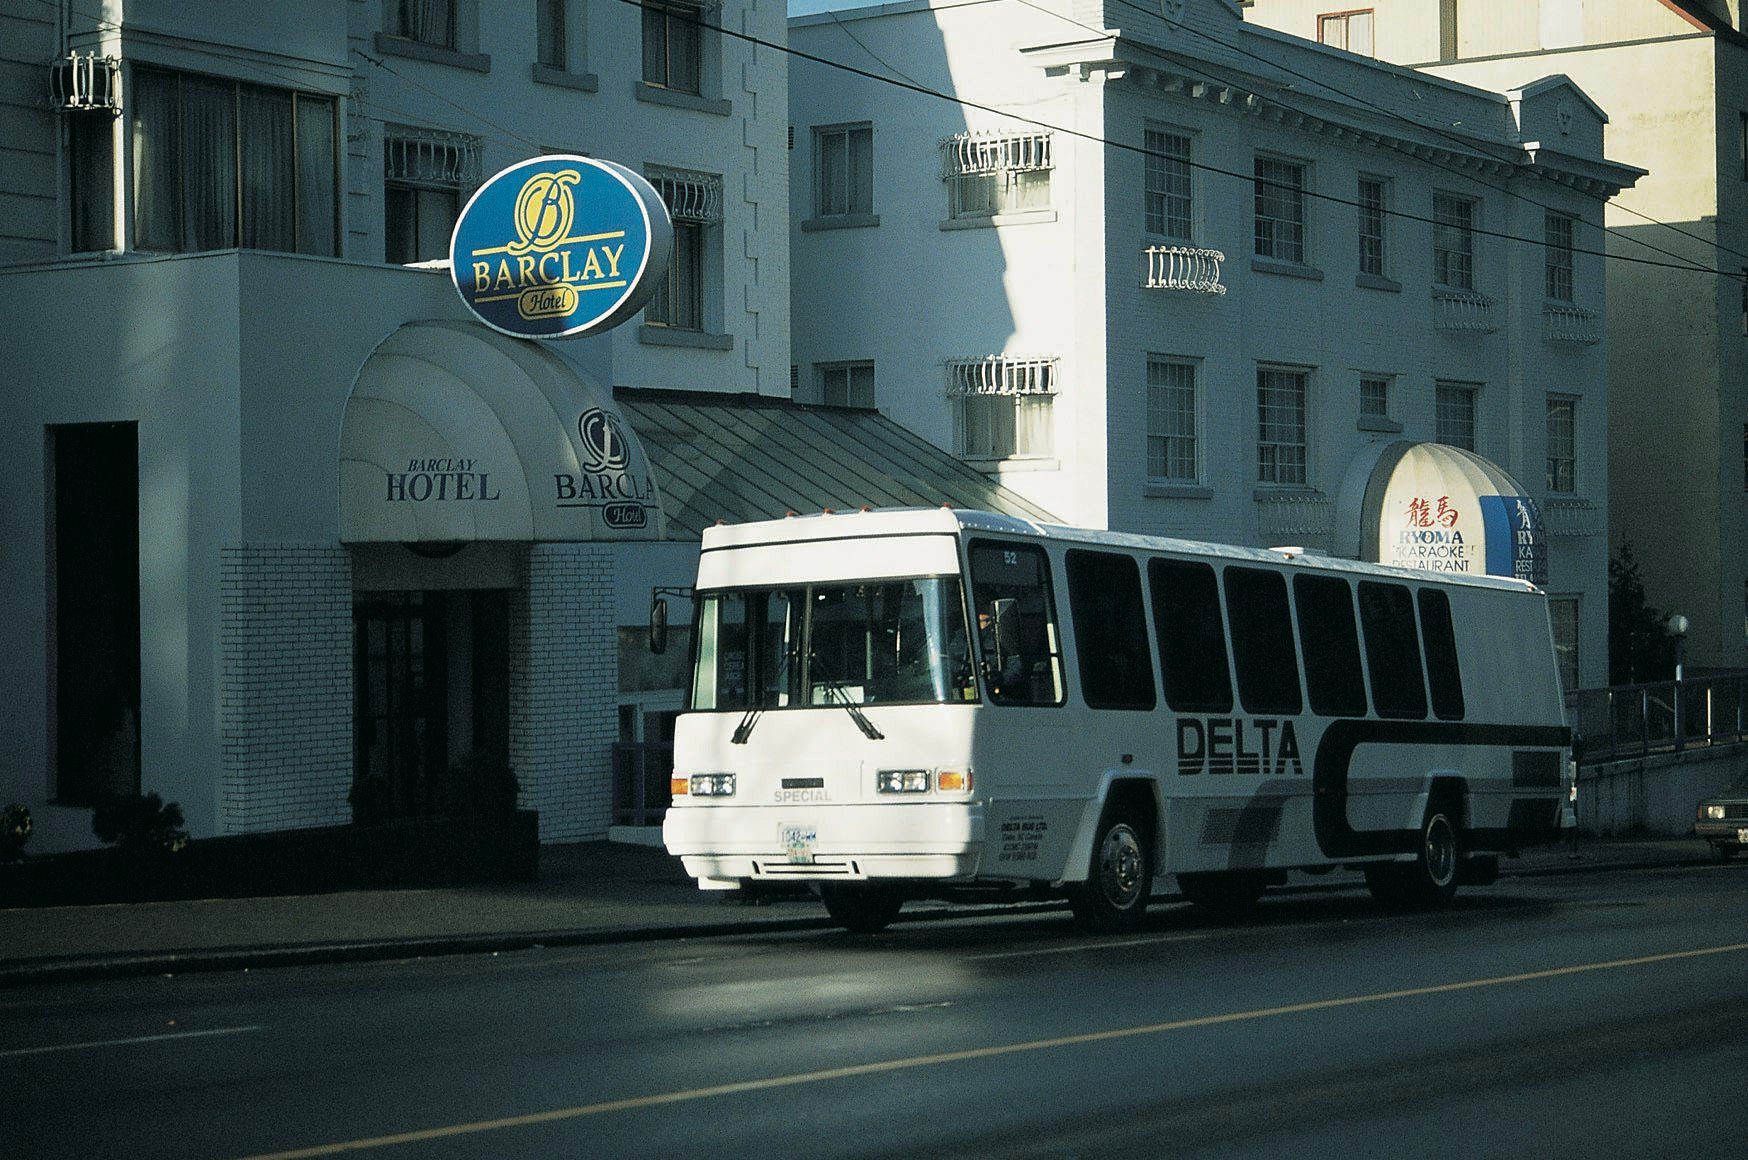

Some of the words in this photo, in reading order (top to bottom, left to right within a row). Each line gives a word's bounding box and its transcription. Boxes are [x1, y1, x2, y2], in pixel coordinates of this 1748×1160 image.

[473, 244, 624, 293] BARCLAY
[530, 287, 566, 311] Hotel
[408, 458, 478, 473] BARCLAY
[385, 472, 501, 502] HOTEL
[1399, 530, 1464, 545] RYOMA
[1004, 551, 1018, 565] 52
[1399, 545, 1464, 558] KARAOKE
[1176, 718, 1304, 776] DELTA
[774, 790, 832, 803] SPECIAL
